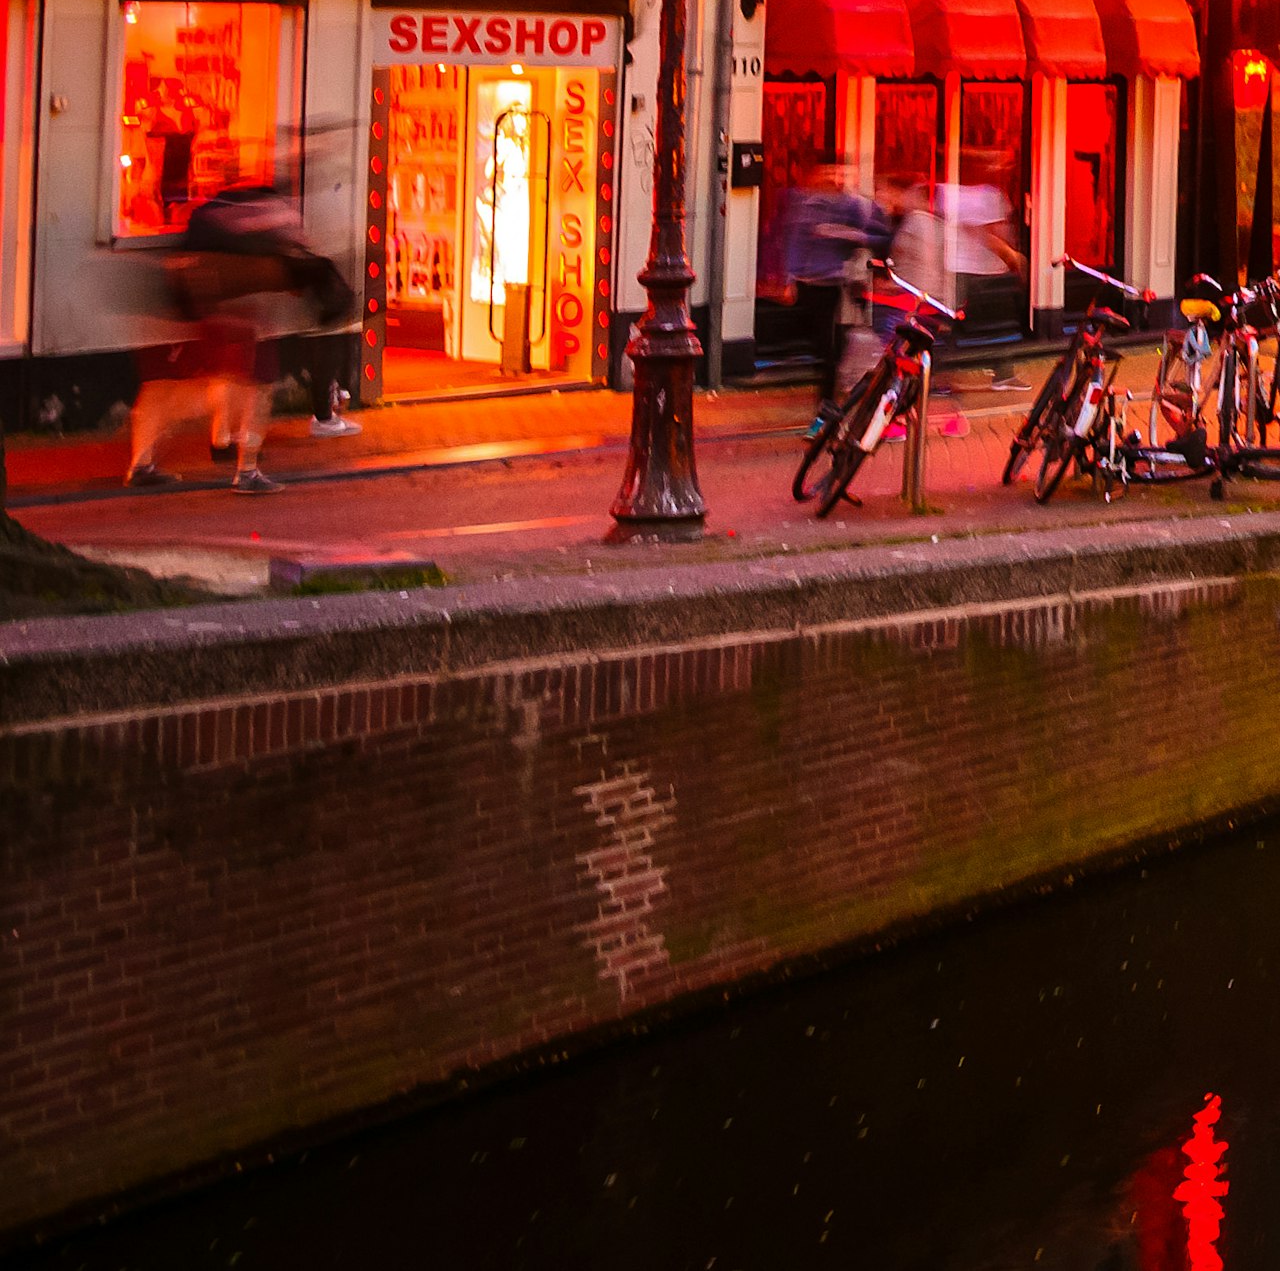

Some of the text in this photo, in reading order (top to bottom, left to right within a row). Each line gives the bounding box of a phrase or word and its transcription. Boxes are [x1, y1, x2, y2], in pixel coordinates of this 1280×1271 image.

[388, 13, 607, 57] SEXSHOP
[732, 56, 761, 77] 110
[554, 80, 586, 367] SEX SHOP
